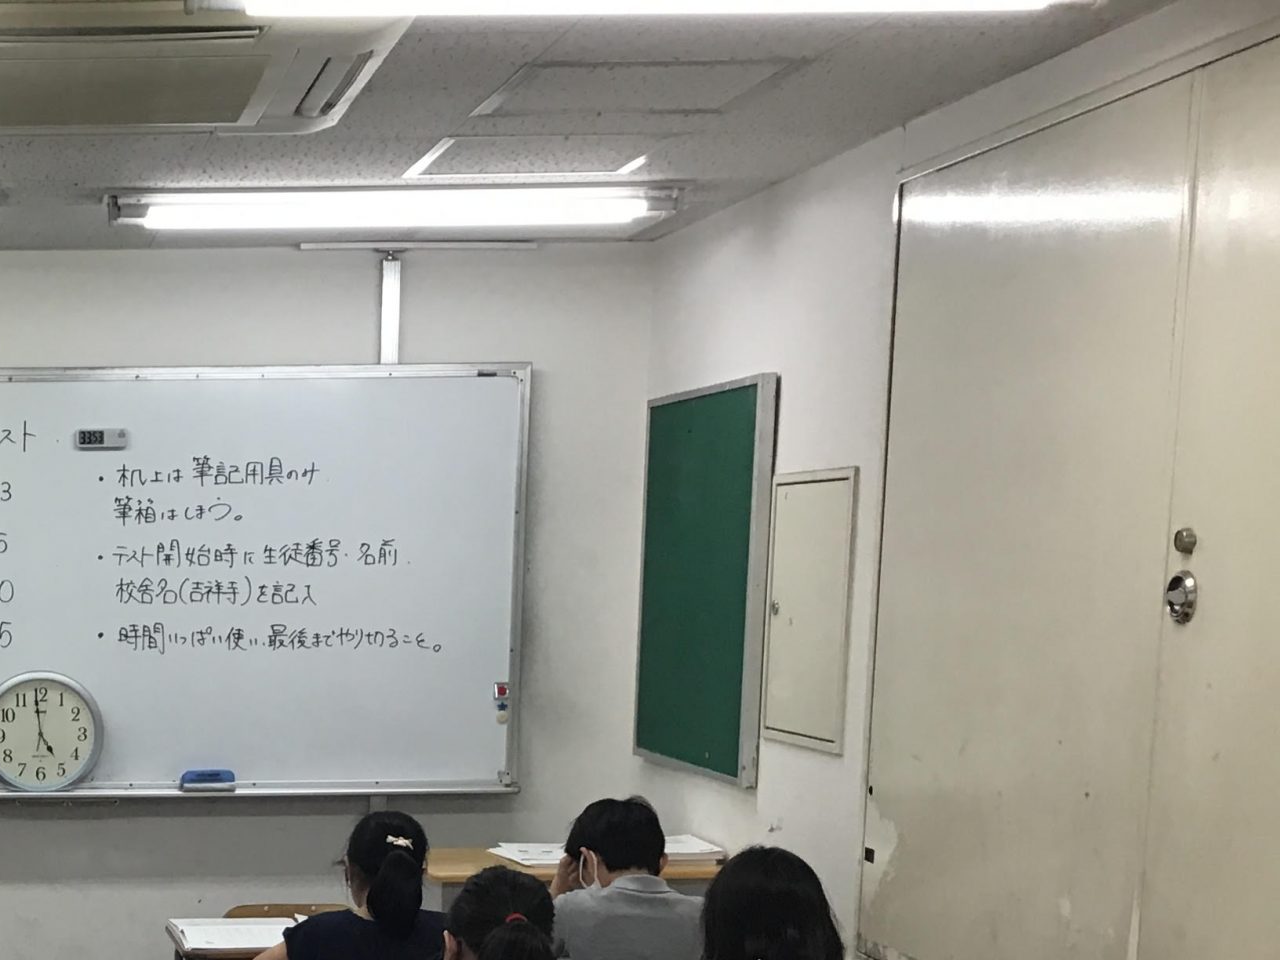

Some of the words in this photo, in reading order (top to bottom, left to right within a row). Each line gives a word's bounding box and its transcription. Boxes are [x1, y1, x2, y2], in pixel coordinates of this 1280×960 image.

[15, 692, 27, 707] 11
[1, 707, 16, 723] 10
[71, 706, 80, 722] 2
[77, 726, 88, 742] 3
[2, 748, 13, 763] 8
[70, 747, 80, 761] 4
[17, 763, 27, 777] 7
[35, 766, 46, 781] 6
[56, 762, 66, 777] 5
